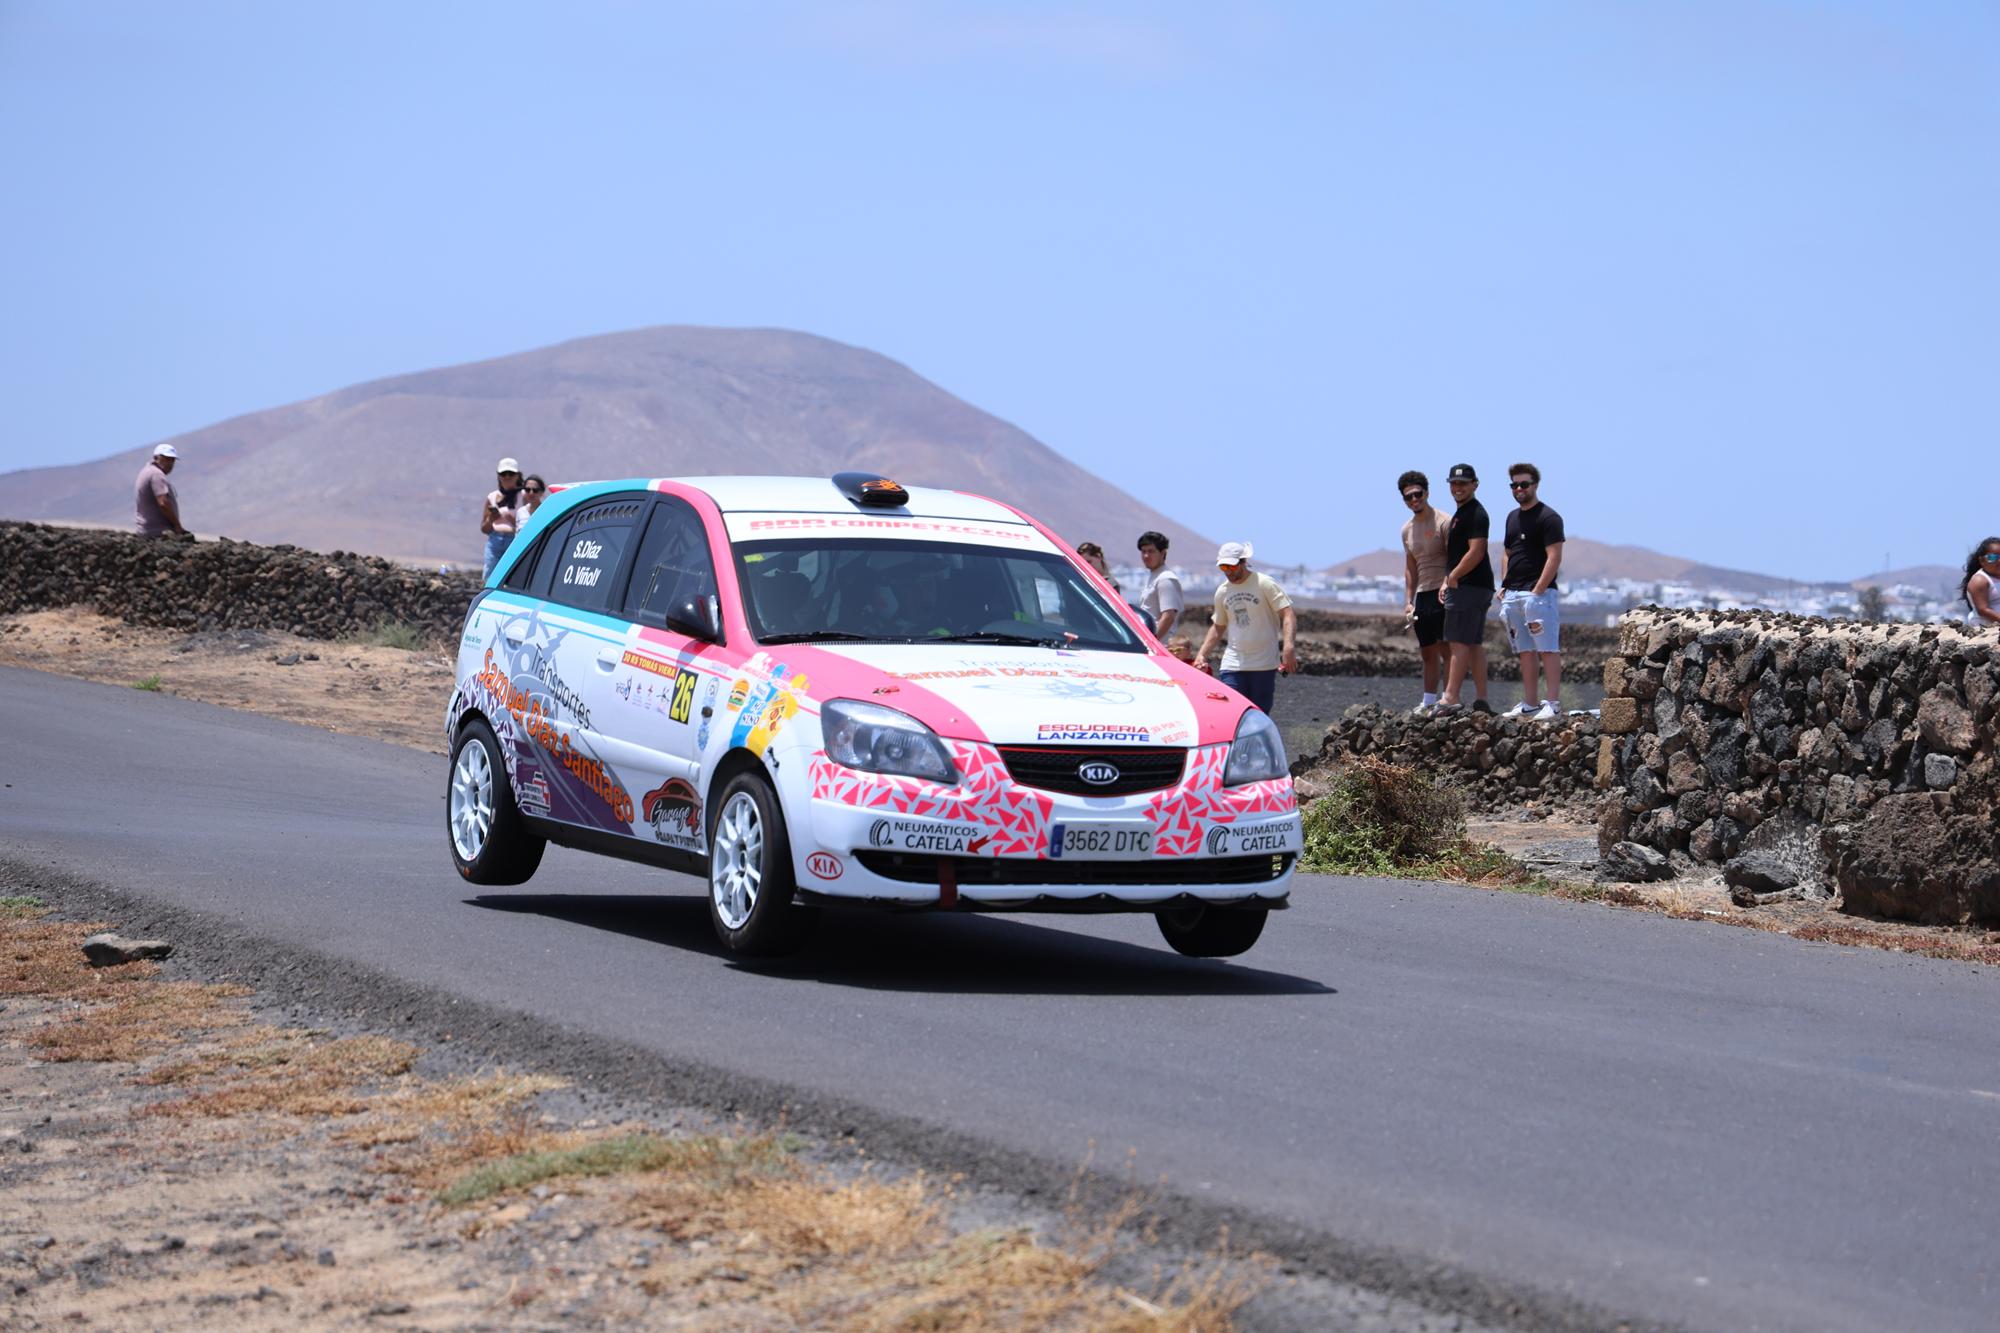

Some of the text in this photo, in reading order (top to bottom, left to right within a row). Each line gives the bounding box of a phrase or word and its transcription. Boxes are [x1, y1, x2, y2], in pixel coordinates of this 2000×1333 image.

[573, 540, 602, 559] S.Díaz
[563, 564, 574, 584] O.
[530, 643, 591, 729] Transportes
[670, 672, 696, 722] 26
[478, 647, 635, 823] Samuel Díaz Santiago
[1037, 732, 1149, 741] LANZAROTE
[1038, 724, 1149, 733] ESCUDERIA
[1086, 768, 1113, 779] KIA
[650, 800, 690, 832] Garage
[894, 821, 979, 837] NEUMÁTICOS
[1232, 822, 1294, 838] NEUMÁTICOS
[905, 834, 964, 852] CATELA
[1064, 830, 1111, 852] 3562
[1115, 831, 1151, 852] DTC
[1241, 835, 1287, 852] CATELA
[813, 857, 838, 875] KIA
